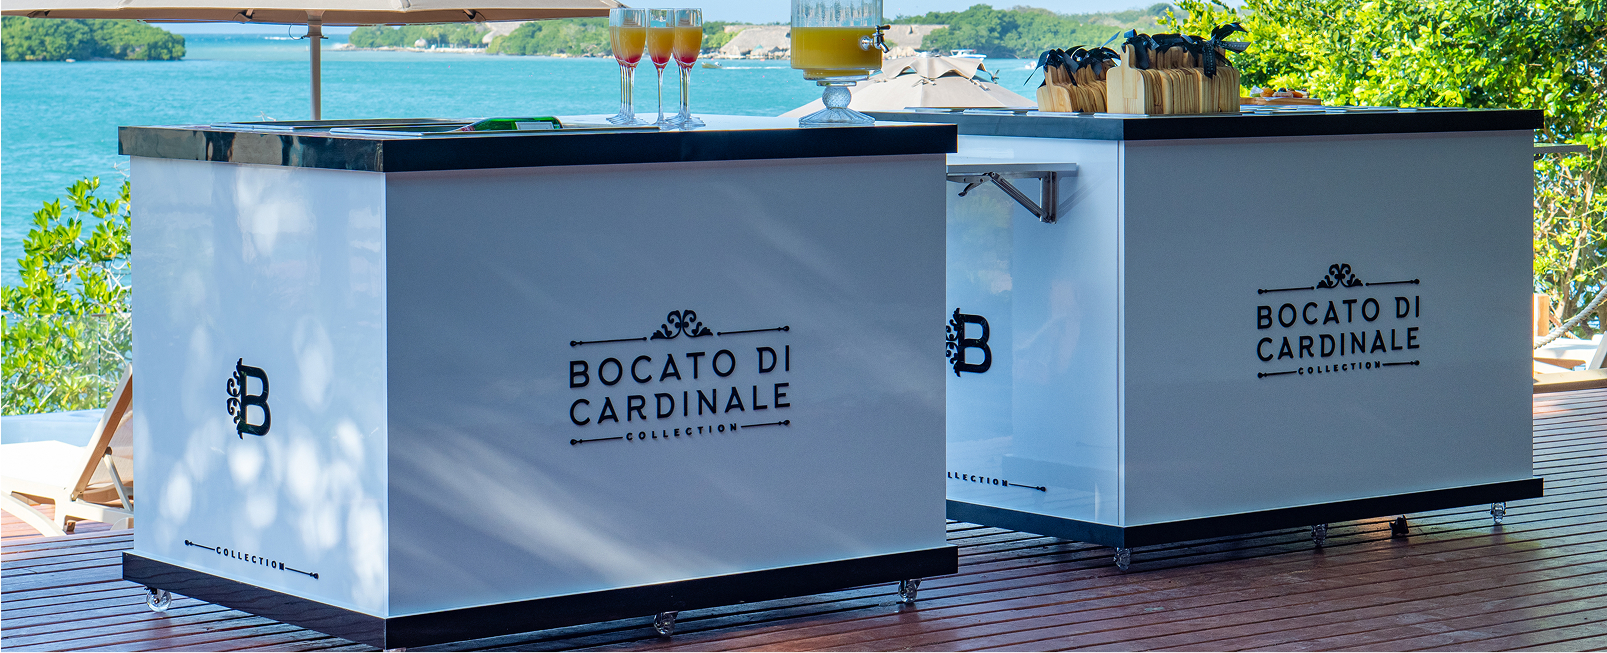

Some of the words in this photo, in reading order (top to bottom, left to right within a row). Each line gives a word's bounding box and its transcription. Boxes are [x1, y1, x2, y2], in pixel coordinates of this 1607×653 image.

[1257, 298, 1380, 330] BOCATO
[1394, 295, 1420, 318] DI
[949, 308, 992, 377] B
[1257, 327, 1420, 362] CARDINALE
[569, 350, 736, 388] BOCATO
[756, 345, 790, 373] DI
[1298, 361, 1381, 375] COLLECTION
[230, 358, 272, 440] B
[569, 382, 791, 426] CARDINALE
[625, 422, 737, 441] COLLECTION
[947, 471, 1008, 486] LLECTION
[215, 546, 285, 571] COLLECTION
